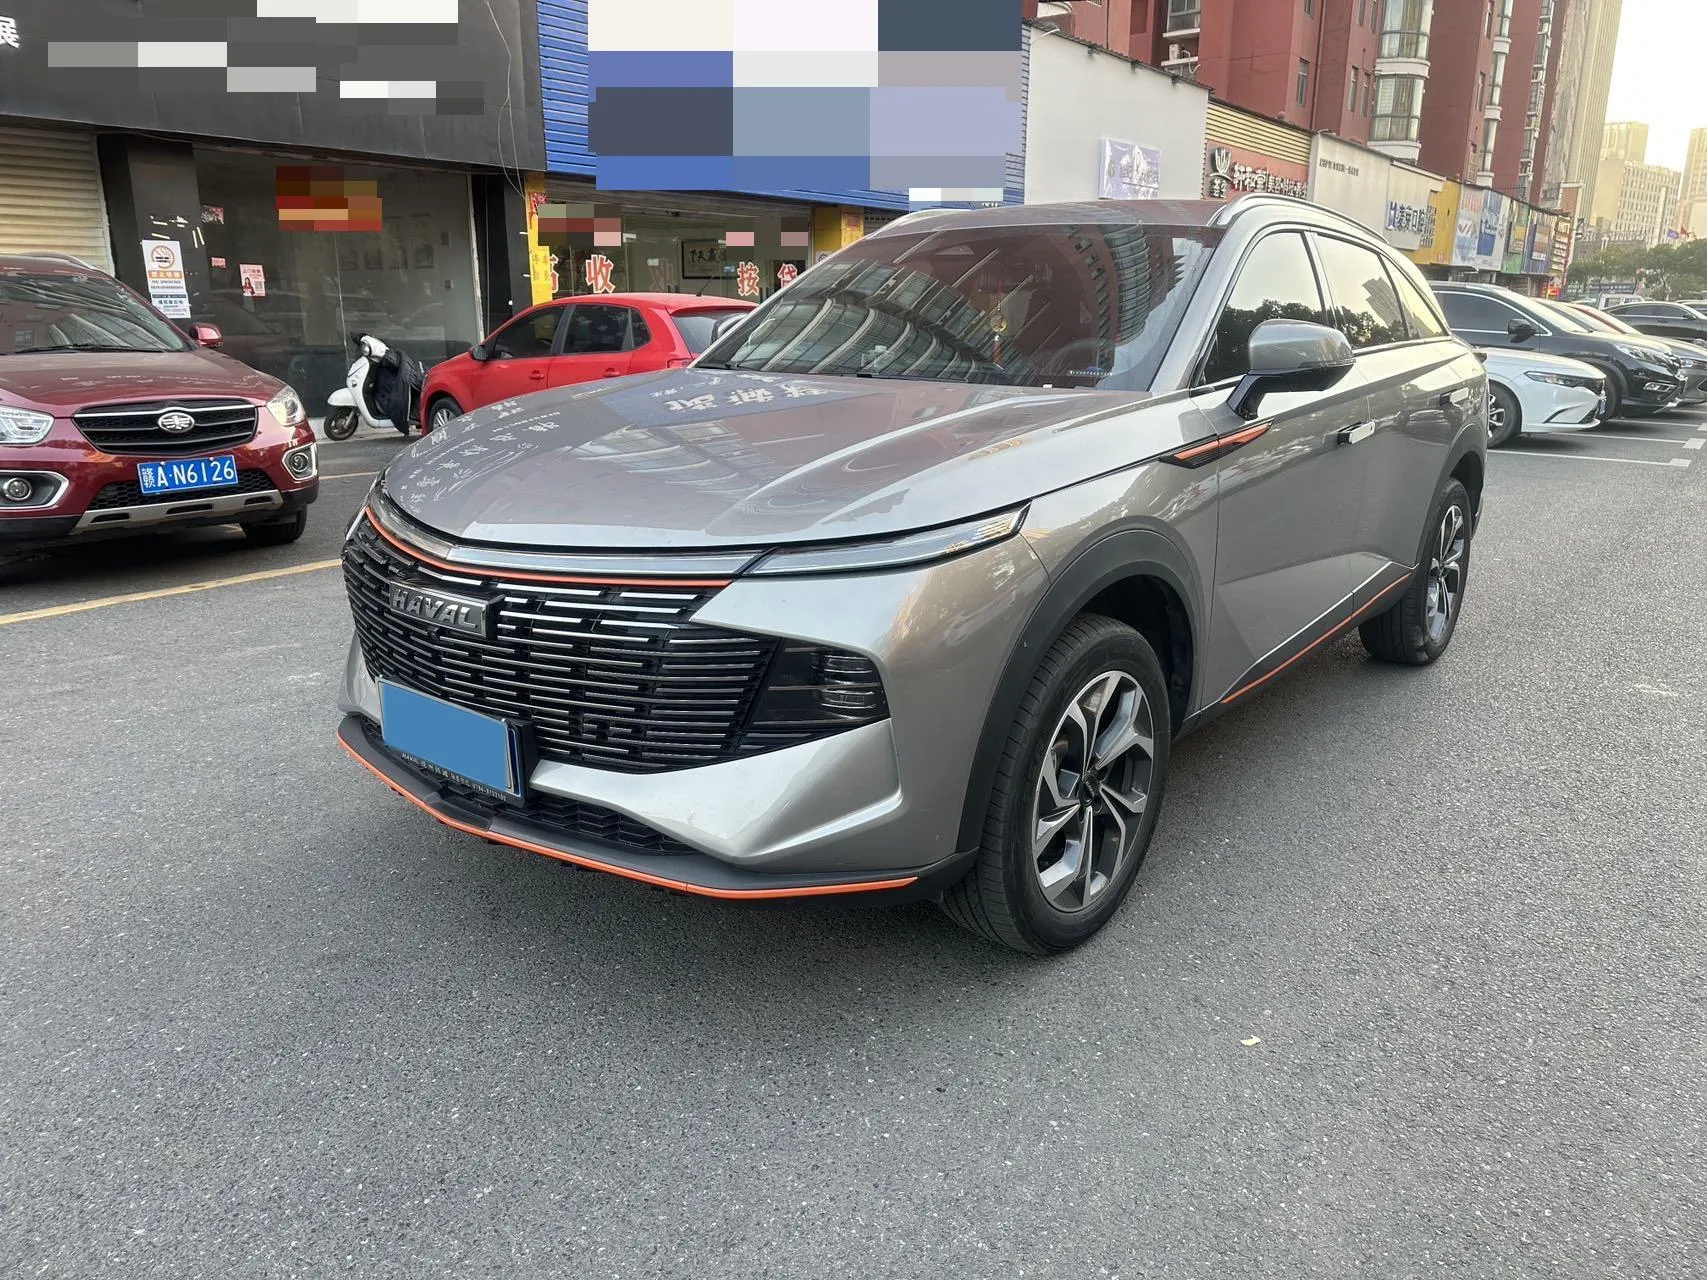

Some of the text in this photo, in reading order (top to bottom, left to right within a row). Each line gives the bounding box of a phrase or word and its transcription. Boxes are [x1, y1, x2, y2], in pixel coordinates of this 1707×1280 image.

[585, 254, 616, 294] 收
[737, 261, 760, 296] 按
[391, 588, 478, 629] HAVAL
